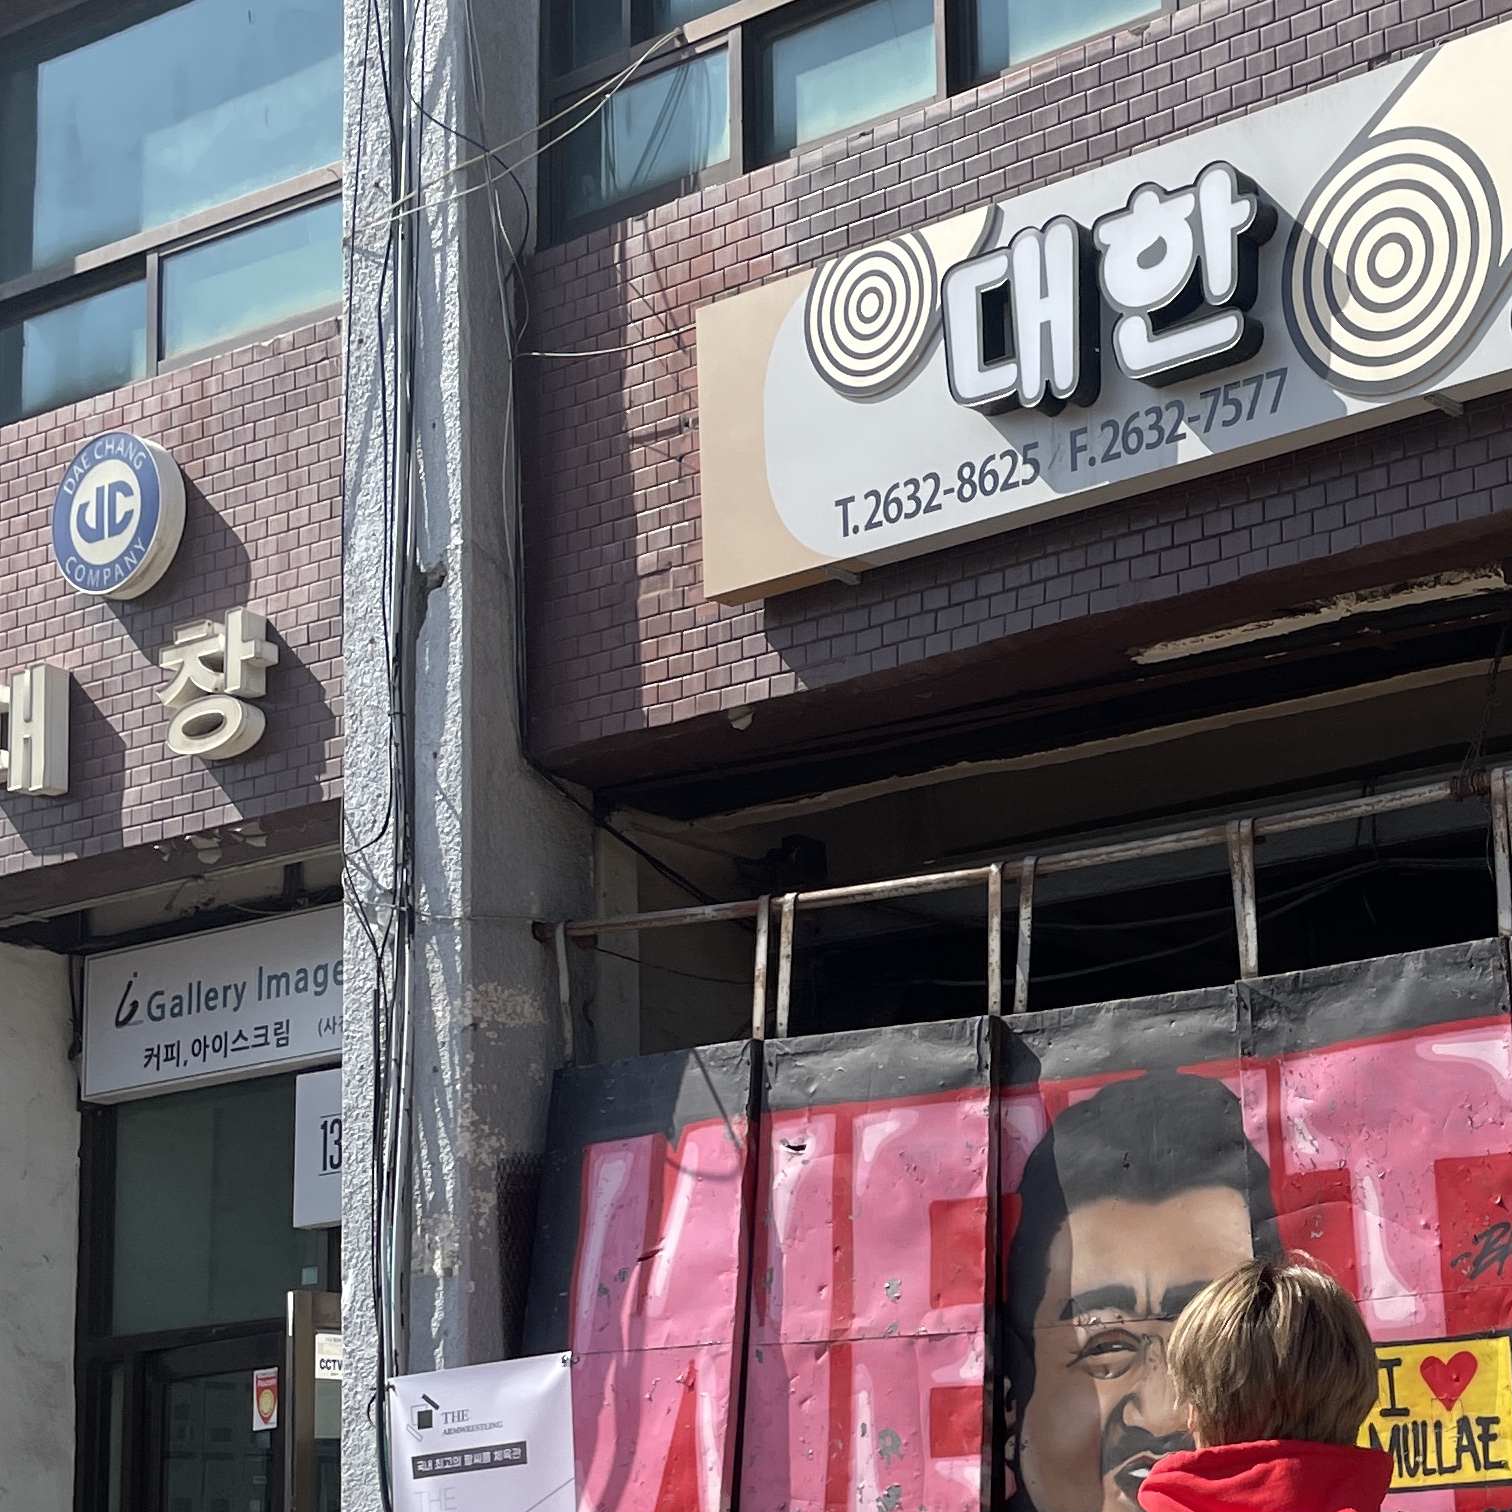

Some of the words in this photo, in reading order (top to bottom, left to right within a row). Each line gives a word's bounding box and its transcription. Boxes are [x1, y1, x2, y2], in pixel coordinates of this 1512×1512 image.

[941, 159, 1275, 415] 대한
[63, 452, 92, 495] DAE
[94, 438, 147, 470] CHANG
[834, 442, 1041, 538] T.2632-8625
[1069, 367, 1288, 472] F.2632-7577
[65, 536, 146, 587] COMPANY
[146, 981, 248, 1022] Gallery
[440, 1409, 470, 1424] THE
[1378, 1359, 1410, 1417] I
[442, 1421, 503, 1436] ARMWRESTLING
[1369, 1416, 1506, 1479] MULLAE
